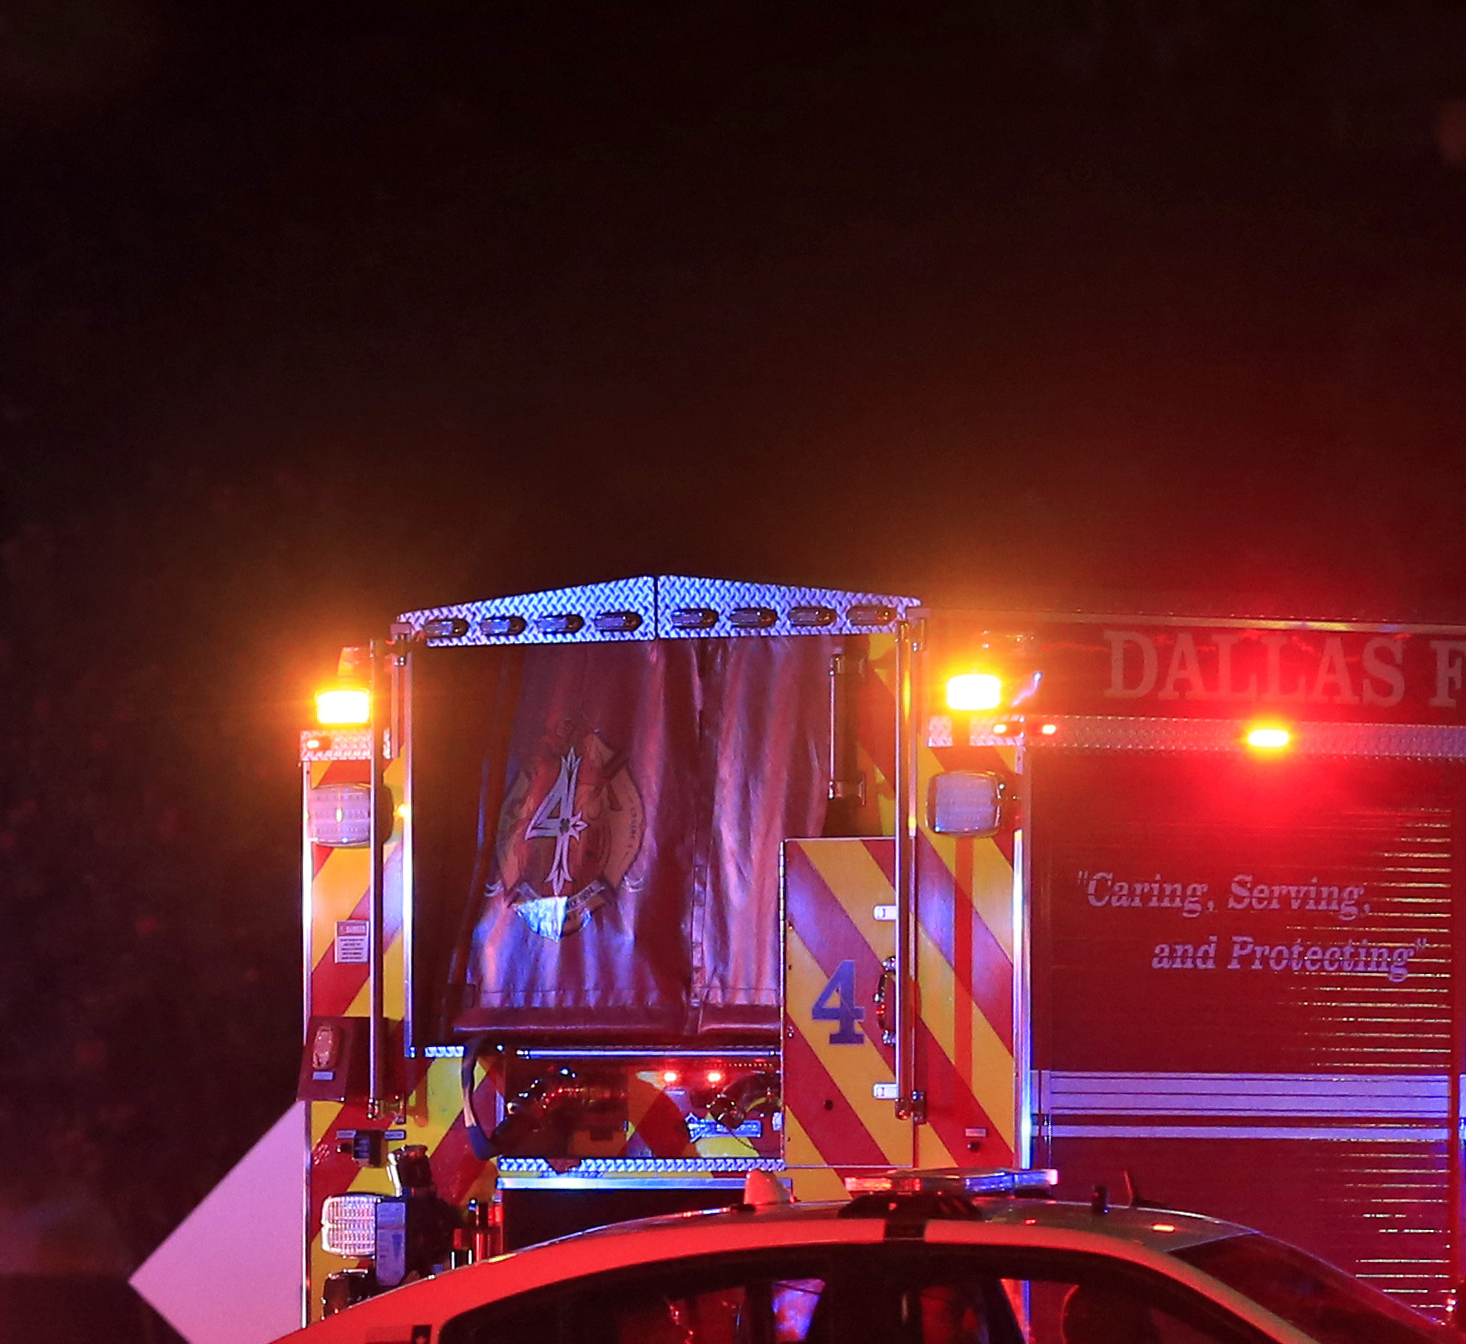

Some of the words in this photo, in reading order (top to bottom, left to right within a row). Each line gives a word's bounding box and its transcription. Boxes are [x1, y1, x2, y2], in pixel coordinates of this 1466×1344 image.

[1103, 630, 1405, 707] DALLAS
[525, 746, 589, 897] 4
[1078, 870, 1215, 918] "Caring,
[1228, 873, 1371, 921] Serving,
[1151, 935, 1218, 970] and
[1227, 935, 1427, 983] Protecting"
[811, 960, 865, 1044] 4
